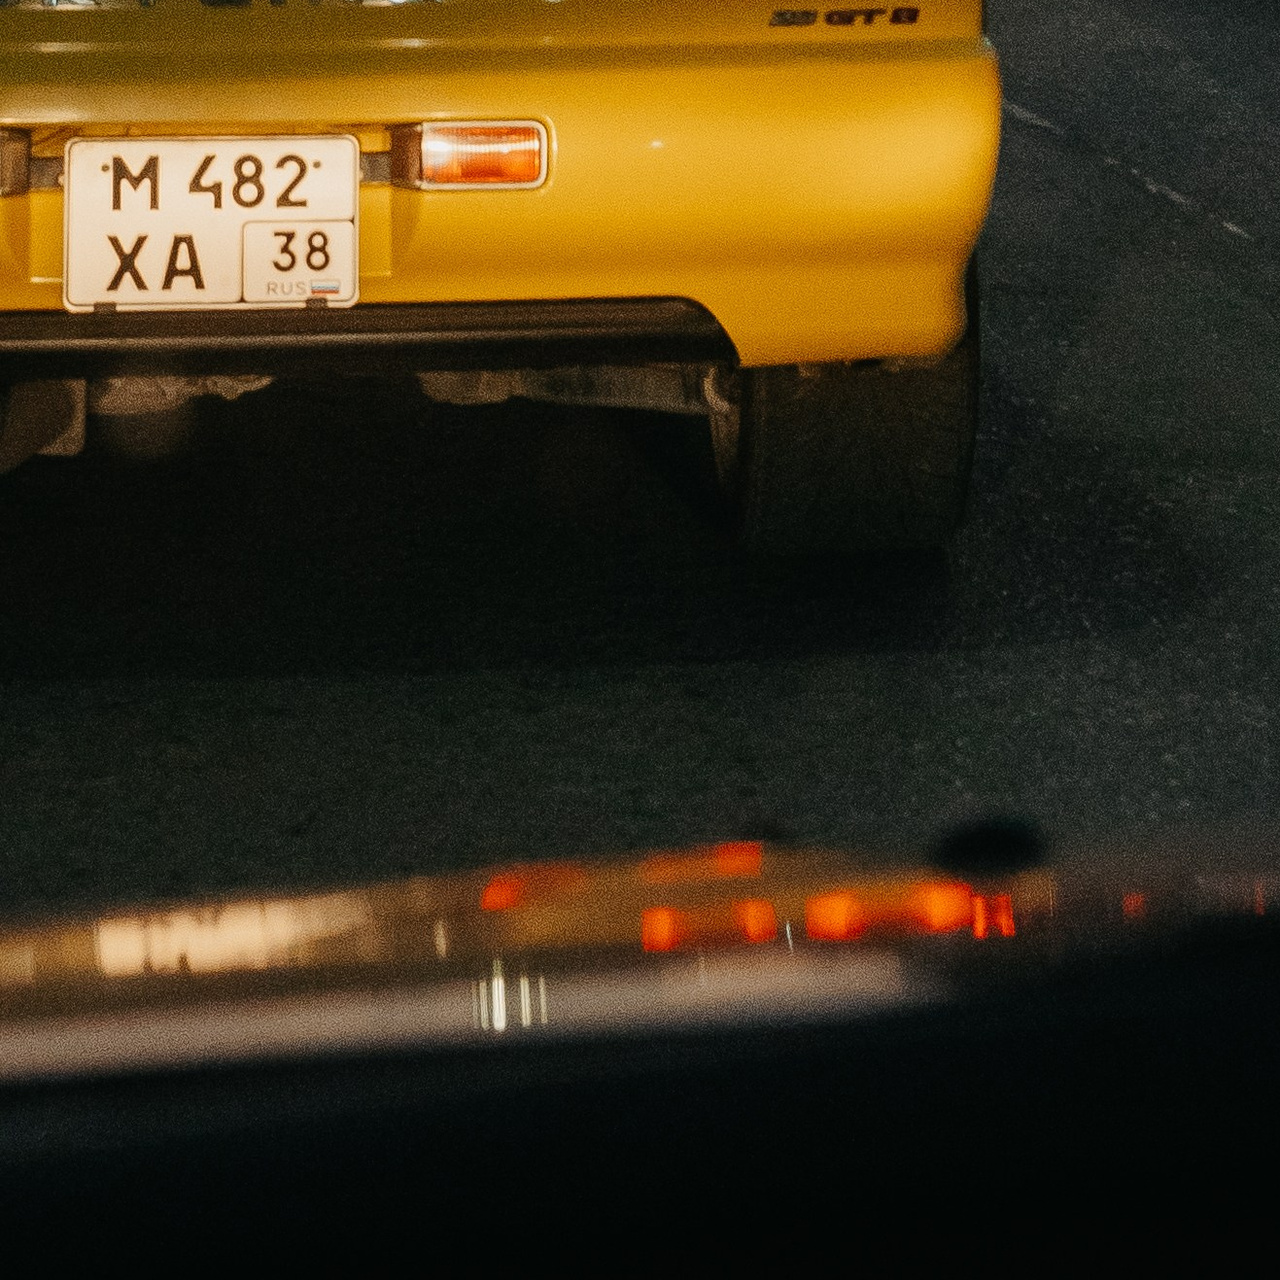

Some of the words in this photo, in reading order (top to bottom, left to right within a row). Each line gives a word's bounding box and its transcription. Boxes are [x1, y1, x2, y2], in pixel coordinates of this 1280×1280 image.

[111, 155, 160, 211] М
[188, 154, 308, 210] 482
[106, 234, 206, 291] ХА
[272, 230, 331, 272] 38
[265, 280, 308, 297] RUS
